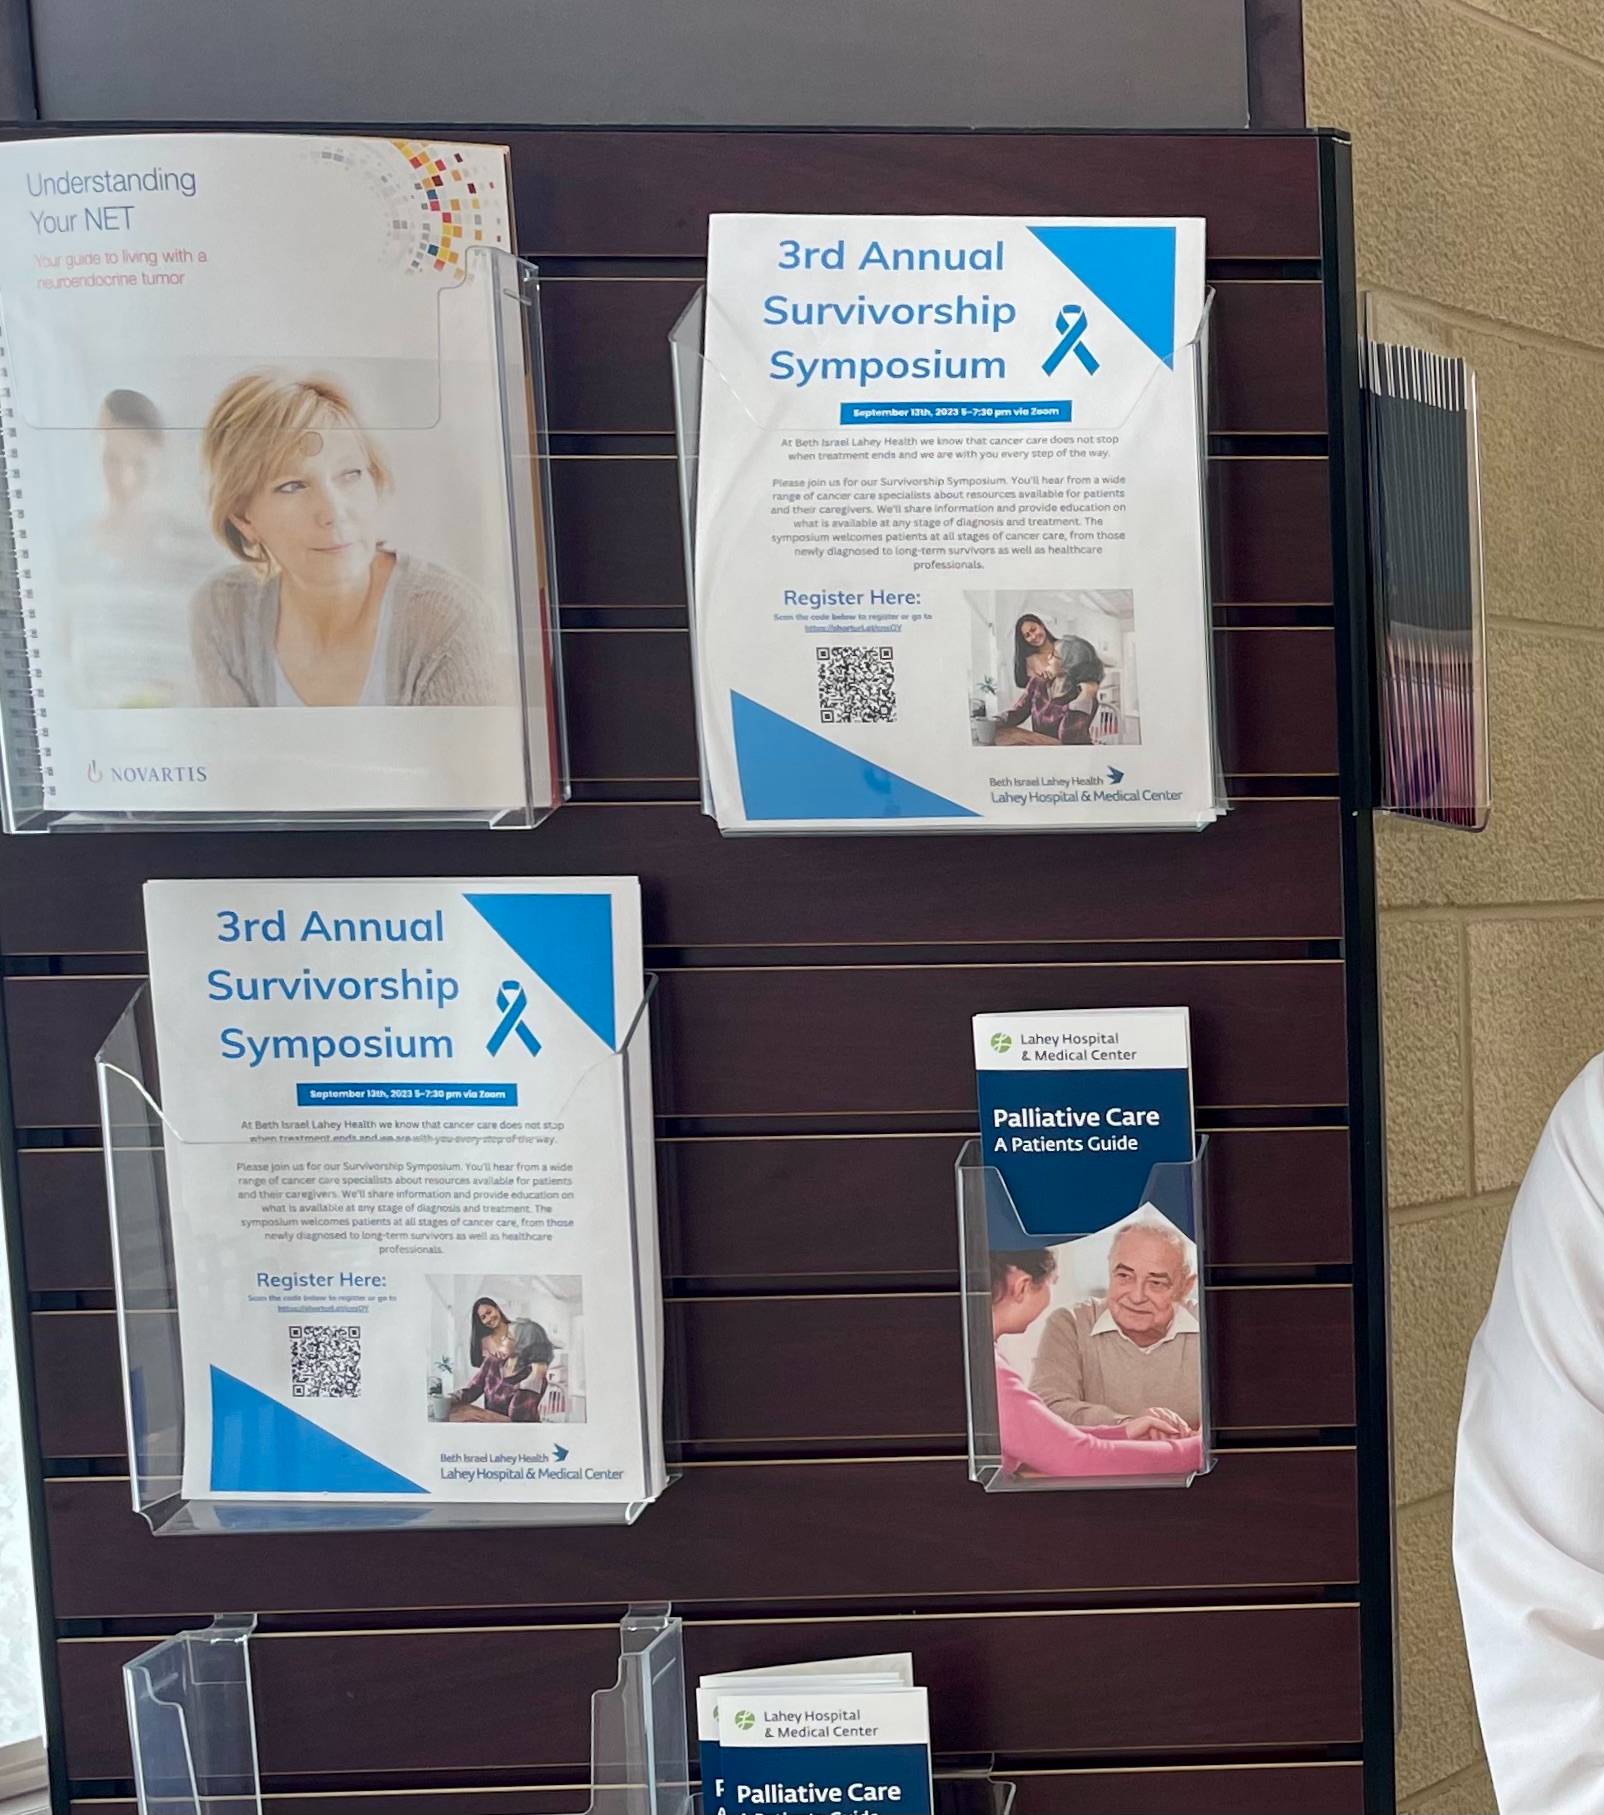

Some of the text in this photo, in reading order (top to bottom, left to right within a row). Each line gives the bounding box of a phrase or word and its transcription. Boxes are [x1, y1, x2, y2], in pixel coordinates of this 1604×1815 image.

[27, 167, 196, 197] Understanding
[30, 206, 135, 235] Your NET
[36, 248, 207, 269] Your guide to living with a
[777, 239, 1004, 271] 3rd Annual
[38, 272, 185, 290] neuroendocrine tumor
[763, 294, 1016, 332] Survivorship
[769, 349, 1006, 387] Symposium
[853, 408, 908, 418] September
[936, 408, 958, 417] 2023
[994, 409, 1012, 418] pm
[1013, 408, 1029, 416] via
[781, 438, 792, 447] At
[796, 438, 818, 447] Beth
[822, 438, 849, 447] Israel
[852, 438, 881, 448] Lahey
[884, 437, 917, 445] Health
[937, 437, 963, 445] know
[966, 436, 987, 445] that
[1050, 436, 1074, 444] does
[1096, 436, 1119, 445] stop
[772, 478, 805, 487] Please
[808, 478, 825, 488] join
[843, 477, 857, 486] for
[880, 477, 944, 488] Survivorship
[947, 477, 1007, 486] Symposium.
[1042, 476, 1064, 484] hear
[1067, 476, 1091, 484] from
[1102, 476, 1126, 484] wide
[772, 493, 800, 502] range
[803, 492, 815, 500] of
[878, 491, 931, 501] specialists
[934, 491, 964, 499] about
[1019, 490, 1064, 498] available
[1066, 489, 1080, 497] for
[1084, 490, 1124, 499] patients
[914, 561, 984, 571] professionals.
[784, 590, 921, 609] Register Here:
[111, 767, 207, 782] NOVARTIS
[989, 776, 1103, 788] Beth Israel Lahey Health
[992, 790, 1183, 805] Lahey Hospital & Medical Center
[217, 910, 444, 942] 3rd Annual
[208, 969, 459, 1007] Survivorship
[221, 1027, 453, 1066] Symposium
[1021, 1033, 1119, 1047] Lahey Hospital
[1022, 1050, 1136, 1061] & Medical Center
[310, 1090, 365, 1099] September
[391, 1090, 412, 1098] 2023
[463, 1090, 477, 1098] via
[241, 1121, 251, 1129] At
[255, 1121, 279, 1129] Beth
[282, 1121, 308, 1129] Israel
[312, 1120, 341, 1130] Lahey
[345, 1120, 376, 1129] Health
[395, 1120, 419, 1129] know
[422, 1121, 440, 1129] that
[500, 1121, 522, 1129] does
[525, 1121, 541, 1129] not
[543, 1121, 564, 1130] stop
[993, 1107, 1159, 1128] Palliative Care
[994, 1135, 1138, 1152] A Patients Guide
[257, 1273, 386, 1290] Register Here:
[441, 1454, 548, 1465] Beth Israel Lahey Health
[441, 1468, 624, 1482] Lahey Hospital & Medical Center
[764, 1710, 860, 1724] Lahey Hospital
[765, 1726, 878, 1738] & Medical Center
[737, 1783, 842, 1803] Palliative
[848, 1783, 901, 1802] Care
